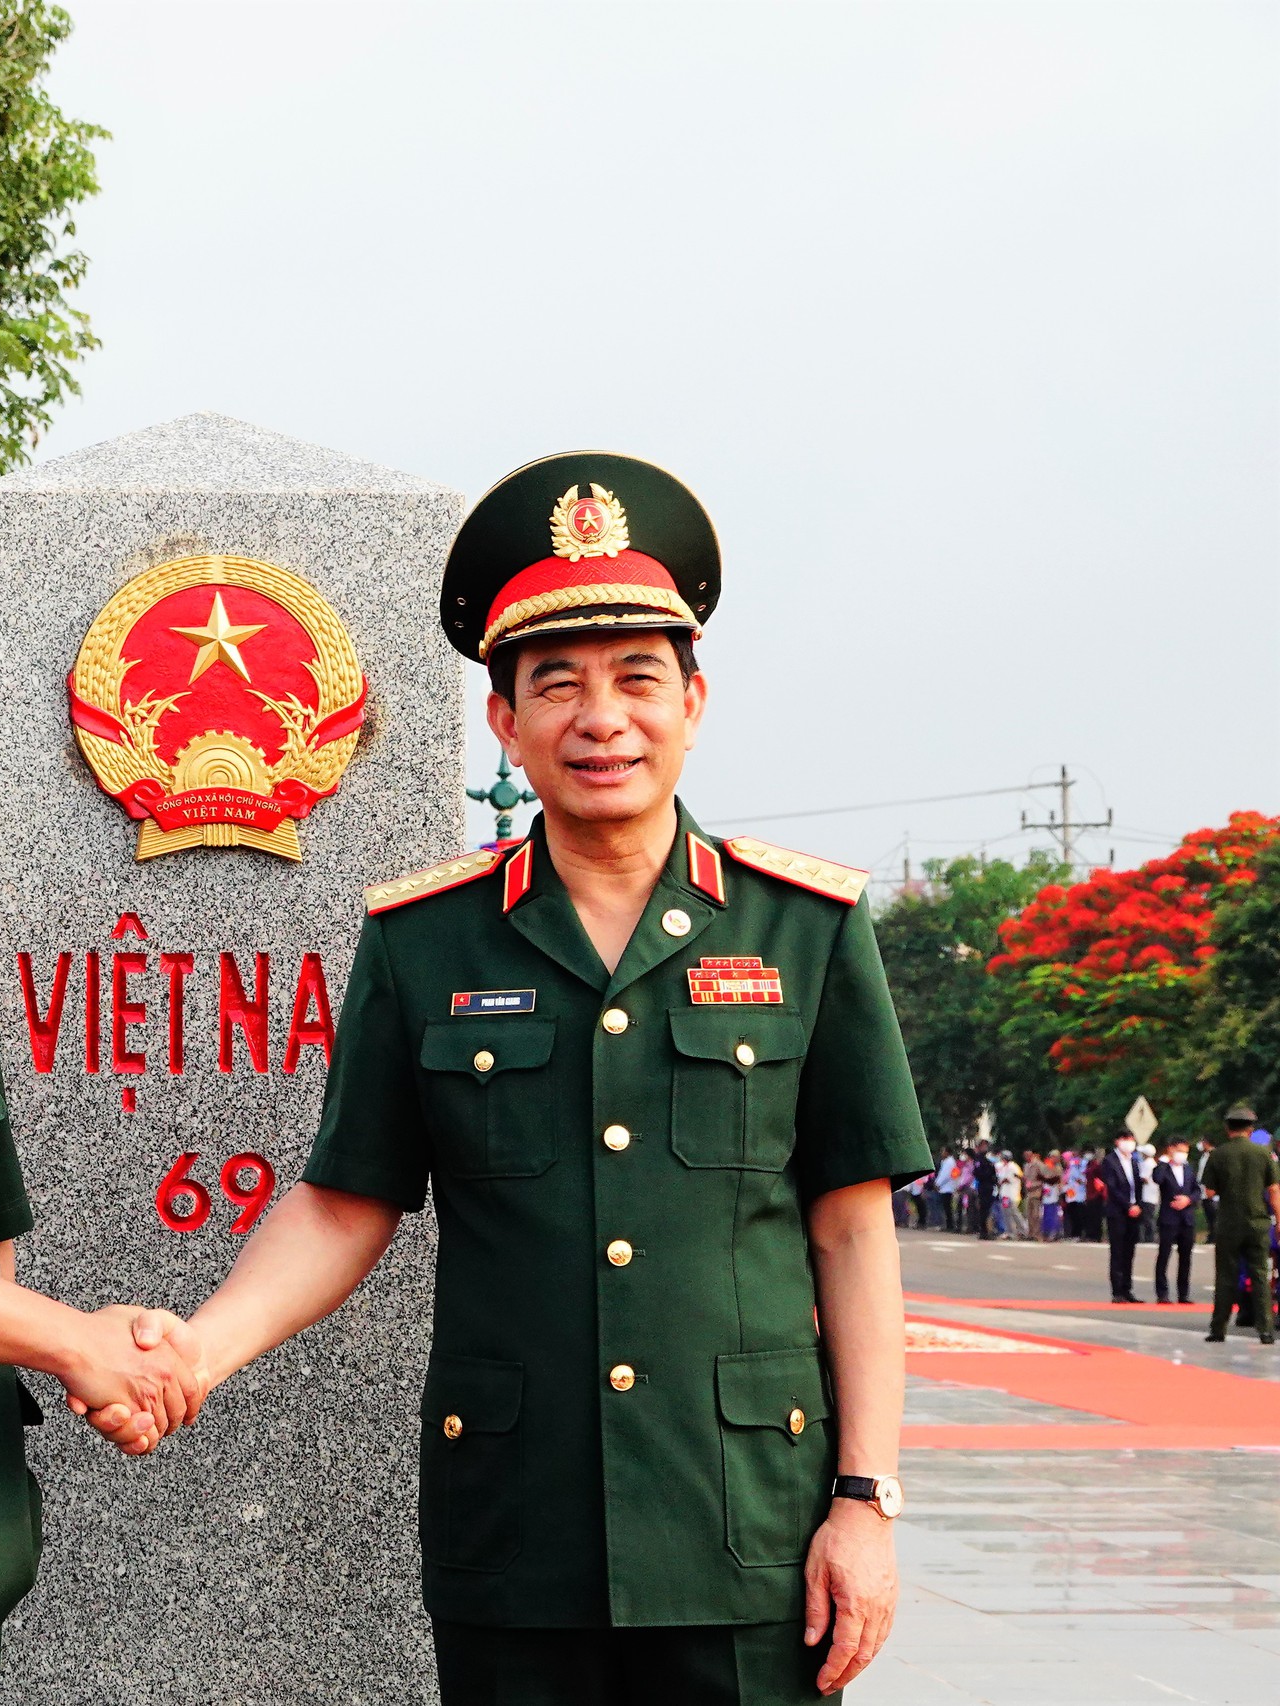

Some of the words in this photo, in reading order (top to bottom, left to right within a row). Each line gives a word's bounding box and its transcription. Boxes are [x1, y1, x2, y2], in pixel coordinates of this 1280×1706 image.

[156, 798, 182, 812] CỘNG
[184, 793, 202, 805] HÒA
[205, 792, 217, 802] XÃ
[219, 793, 234, 804] HỘI
[236, 795, 253, 805] CHỦ
[255, 799, 281, 813] NGHĨA
[182, 805, 218, 820] VIỆT
[224, 807, 256, 820] NAM
[17, 911, 194, 1113] VIỆT
[219, 952, 337, 1074] NA
[155, 1152, 276, 1234] 69
